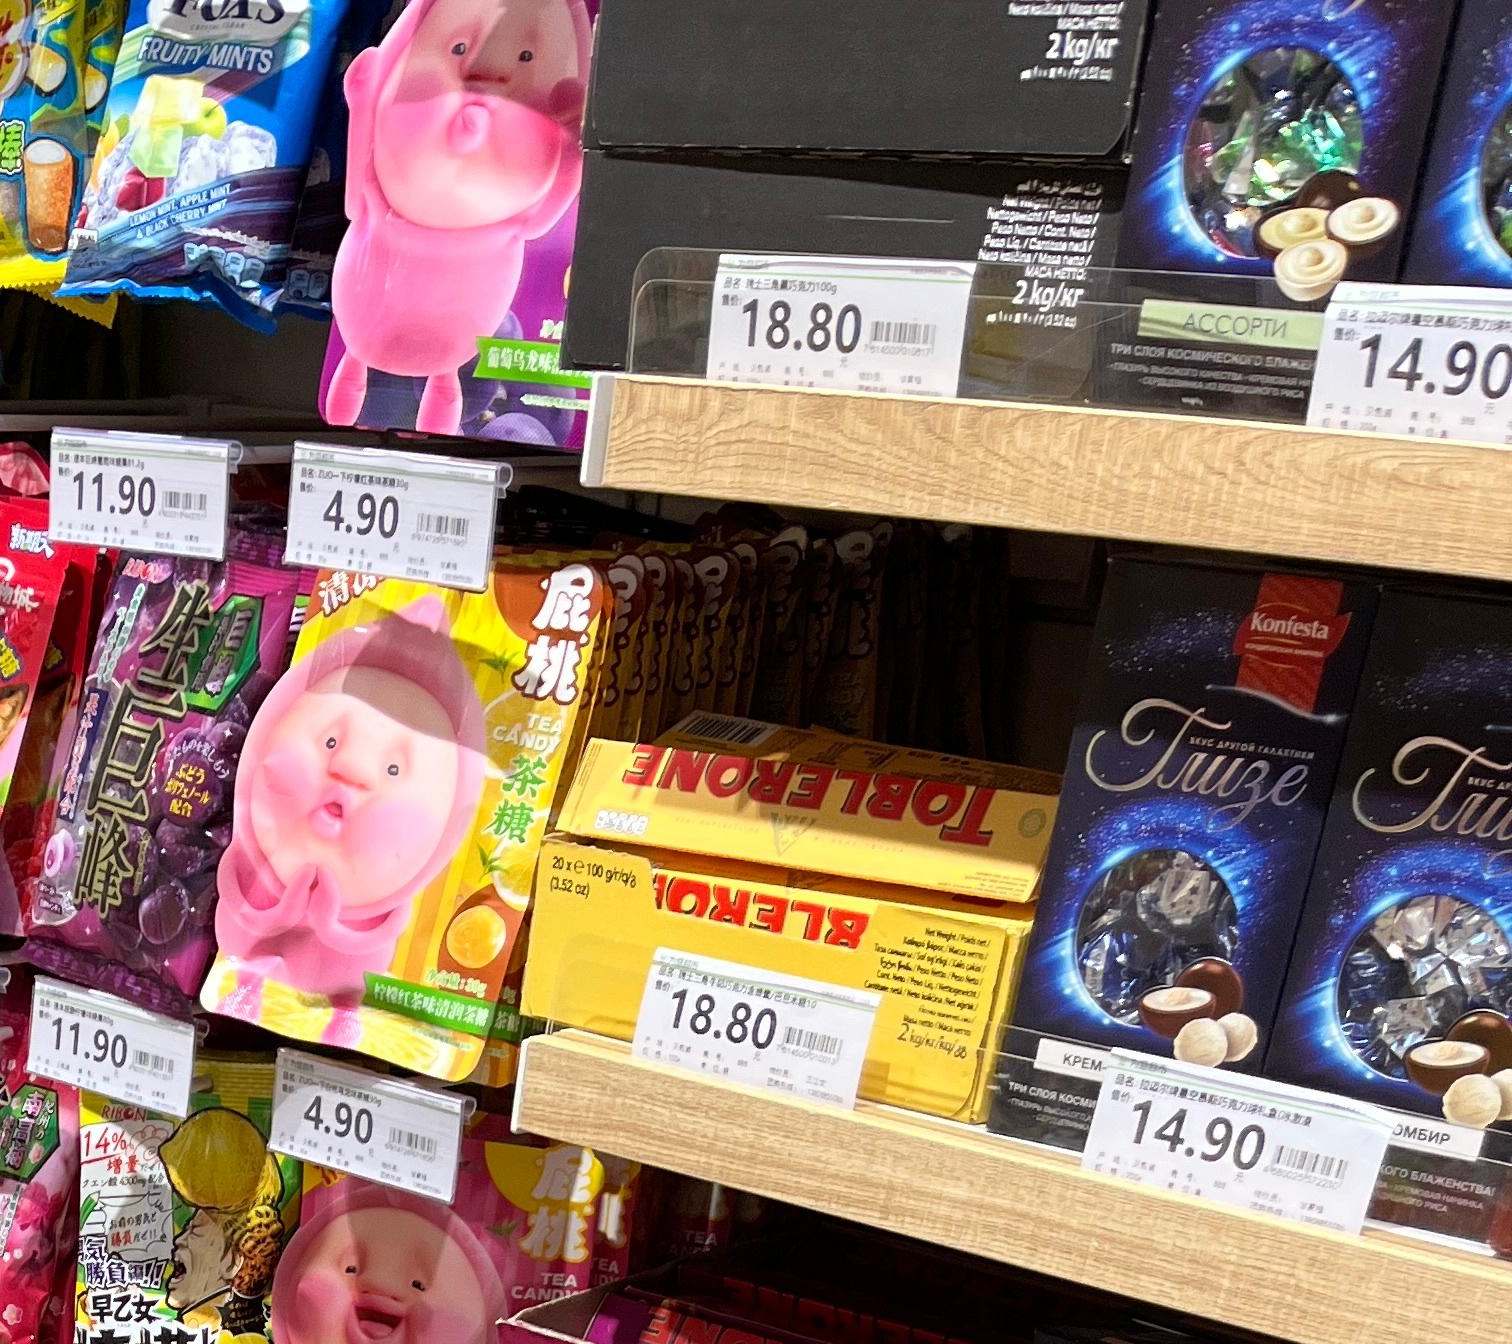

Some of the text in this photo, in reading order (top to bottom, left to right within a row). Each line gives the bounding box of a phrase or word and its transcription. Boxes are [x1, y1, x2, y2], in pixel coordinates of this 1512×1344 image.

[138, 36, 273, 74] FRUITY MINTS
[1046, 33, 1062, 60] 2
[181, 192, 209, 208] APPLE
[209, 184, 232, 199] MINT
[207, 199, 228, 215] MINT
[1012, 280, 1027, 305] 2
[742, 298, 862, 353] 18.80
[1182, 312, 1288, 339] АССОРТИ
[1111, 343, 1261, 367] ТРИ СЛОЯ КОСМИЧЕСКОГО
[1359, 333, 1512, 400] 14.90
[72, 471, 156, 517] 11.90
[323, 491, 399, 539] 4.90
[1250, 612, 1330, 640] Konfesta
[493, 723, 564, 752] CANDY
[526, 713, 563, 737] TEA
[1189, 736, 1215, 749] ВКУС
[1217, 740, 1256, 753] ДРУГОЙ
[482, 754, 548, 844] 茶糖
[622, 744, 996, 845] TOBLERONE
[552, 855, 604, 878] 20 100
[671, 988, 777, 1050] 18.80
[52, 1017, 128, 1068] 11.90
[1029, 1085, 1056, 1099] СЛОЯ
[101, 1105, 147, 1123] RIBON
[304, 1096, 373, 1144] 4.90
[83, 1127, 127, 1158] 14%
[1131, 1099, 1265, 1171] 14.90
[540, 1273, 578, 1289] TEA
[91, 1293, 160, 1324] 早乙女
